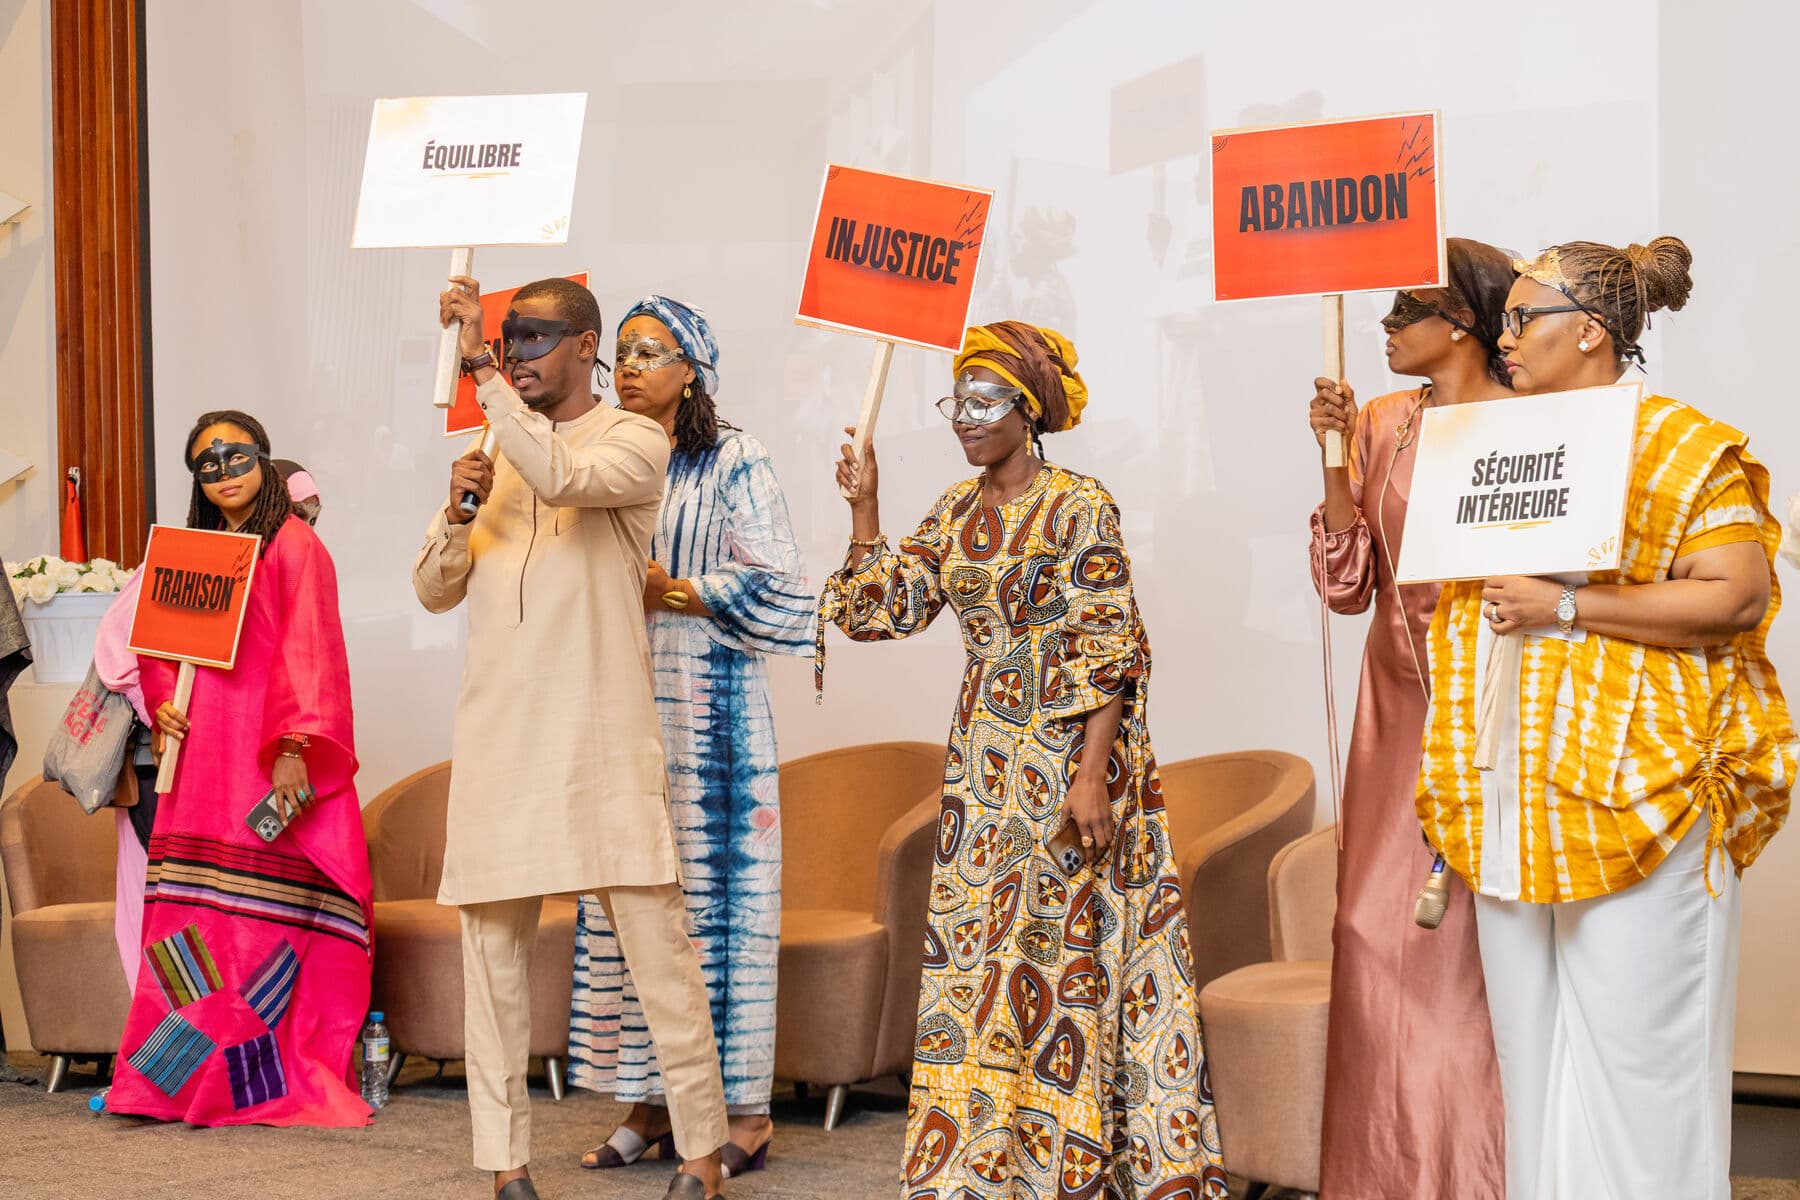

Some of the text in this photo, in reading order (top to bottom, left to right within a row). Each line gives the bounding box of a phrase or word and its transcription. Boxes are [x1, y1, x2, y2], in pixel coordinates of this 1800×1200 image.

[422, 139, 522, 170] ÉQUILIBRE
[1239, 172, 1408, 233] ABANDON
[825, 216, 963, 285] INJUSTICE
[1471, 443, 1566, 487] SÉCURITÉ
[1455, 487, 1570, 524] INTÉRIEURE
[151, 566, 235, 612] TRAHISON
